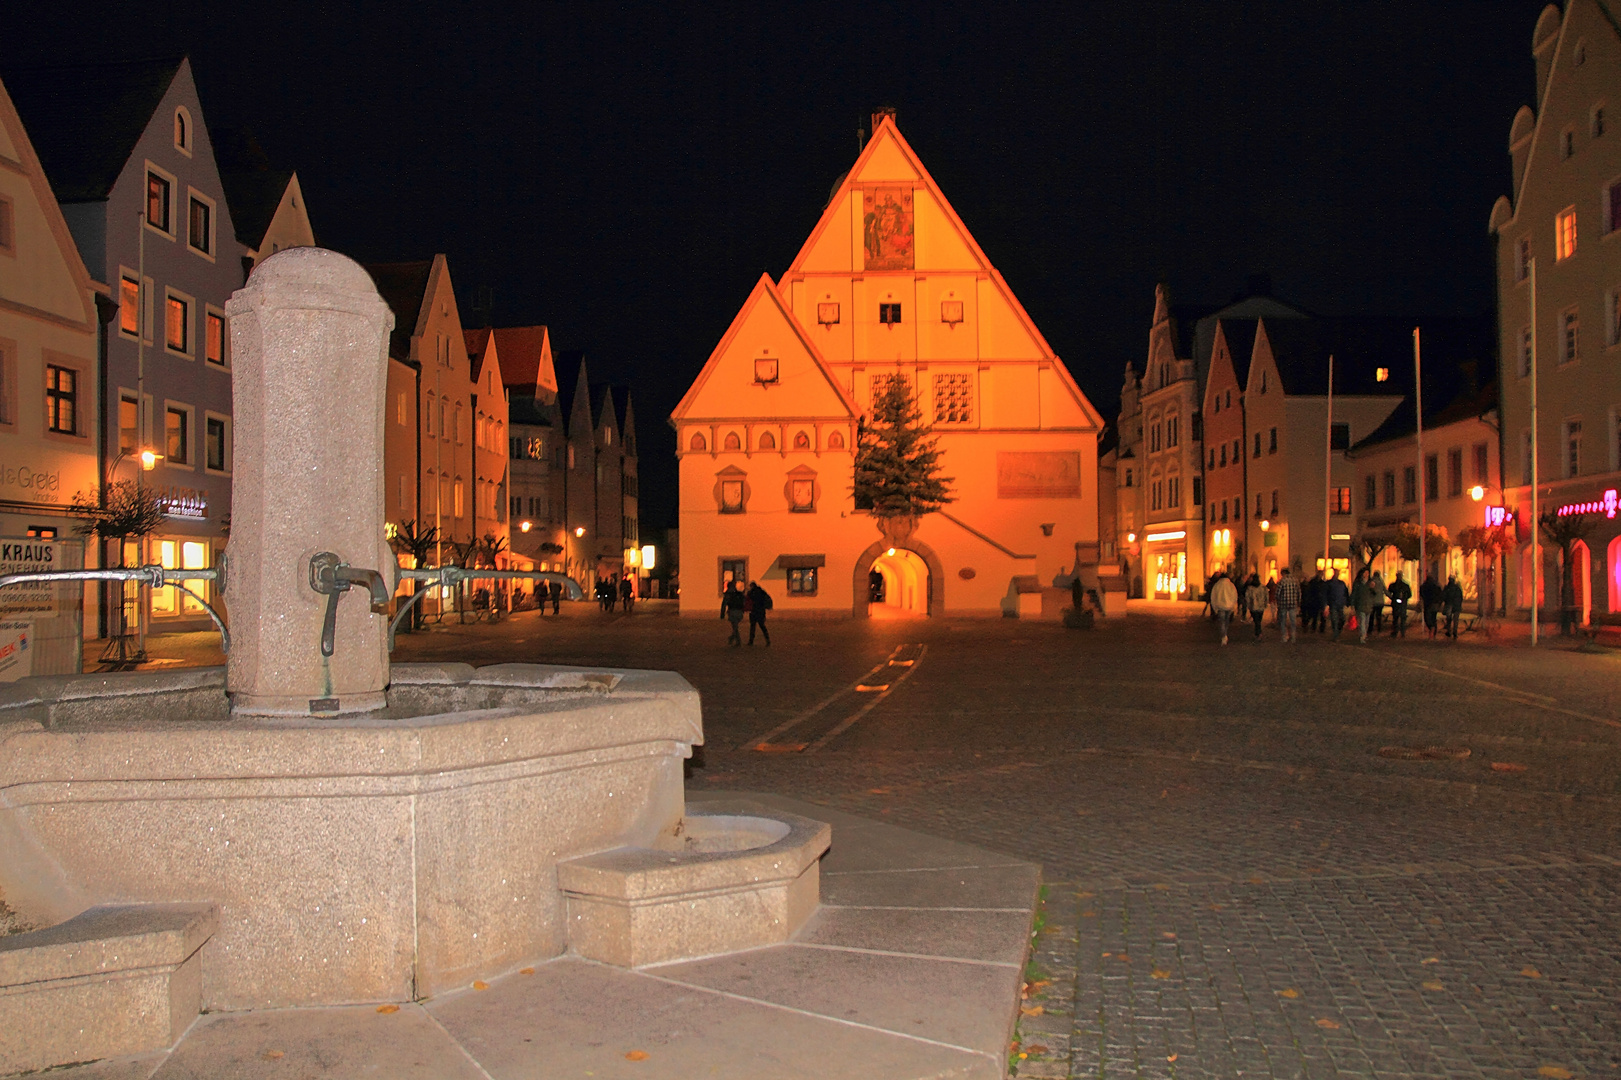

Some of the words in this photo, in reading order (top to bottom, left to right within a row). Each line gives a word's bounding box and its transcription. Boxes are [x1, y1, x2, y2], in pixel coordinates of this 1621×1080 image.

[18, 466, 60, 491] Gretel
[1604, 489, 1617, 518] T
[2, 543, 53, 562] KRAUS
